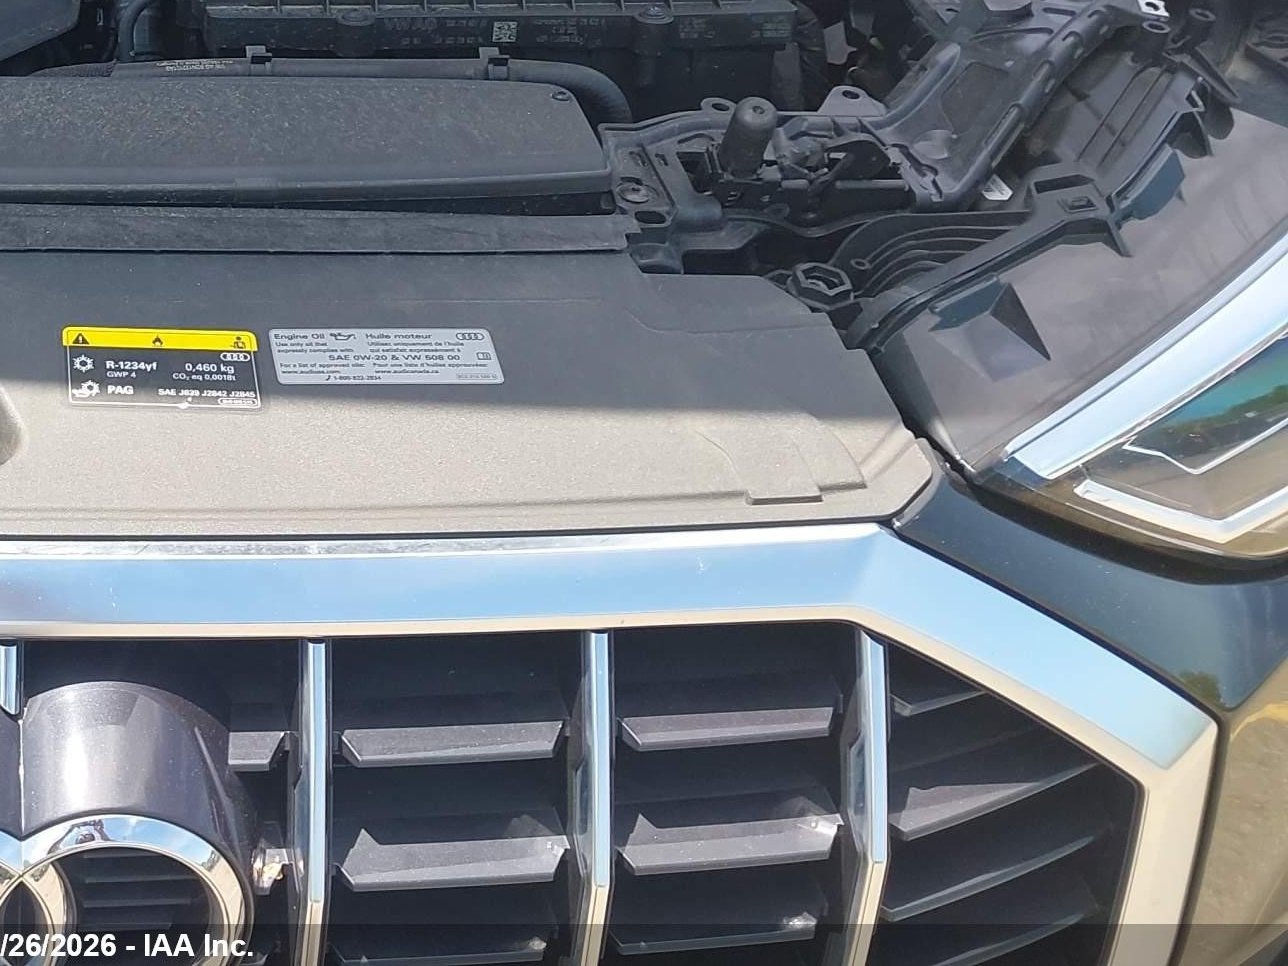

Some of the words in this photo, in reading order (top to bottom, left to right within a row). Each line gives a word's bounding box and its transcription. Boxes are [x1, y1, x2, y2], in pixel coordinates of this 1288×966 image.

[273, 333, 309, 341] Engine
[105, 360, 158, 372] R-1234yf
[184, 363, 218, 372] 0,460
[220, 364, 235, 374] kg
[107, 385, 135, 395] PAG
[158, 388, 177, 396] SAE
[201, 389, 227, 397] J2842
[229, 390, 256, 398] J2845
